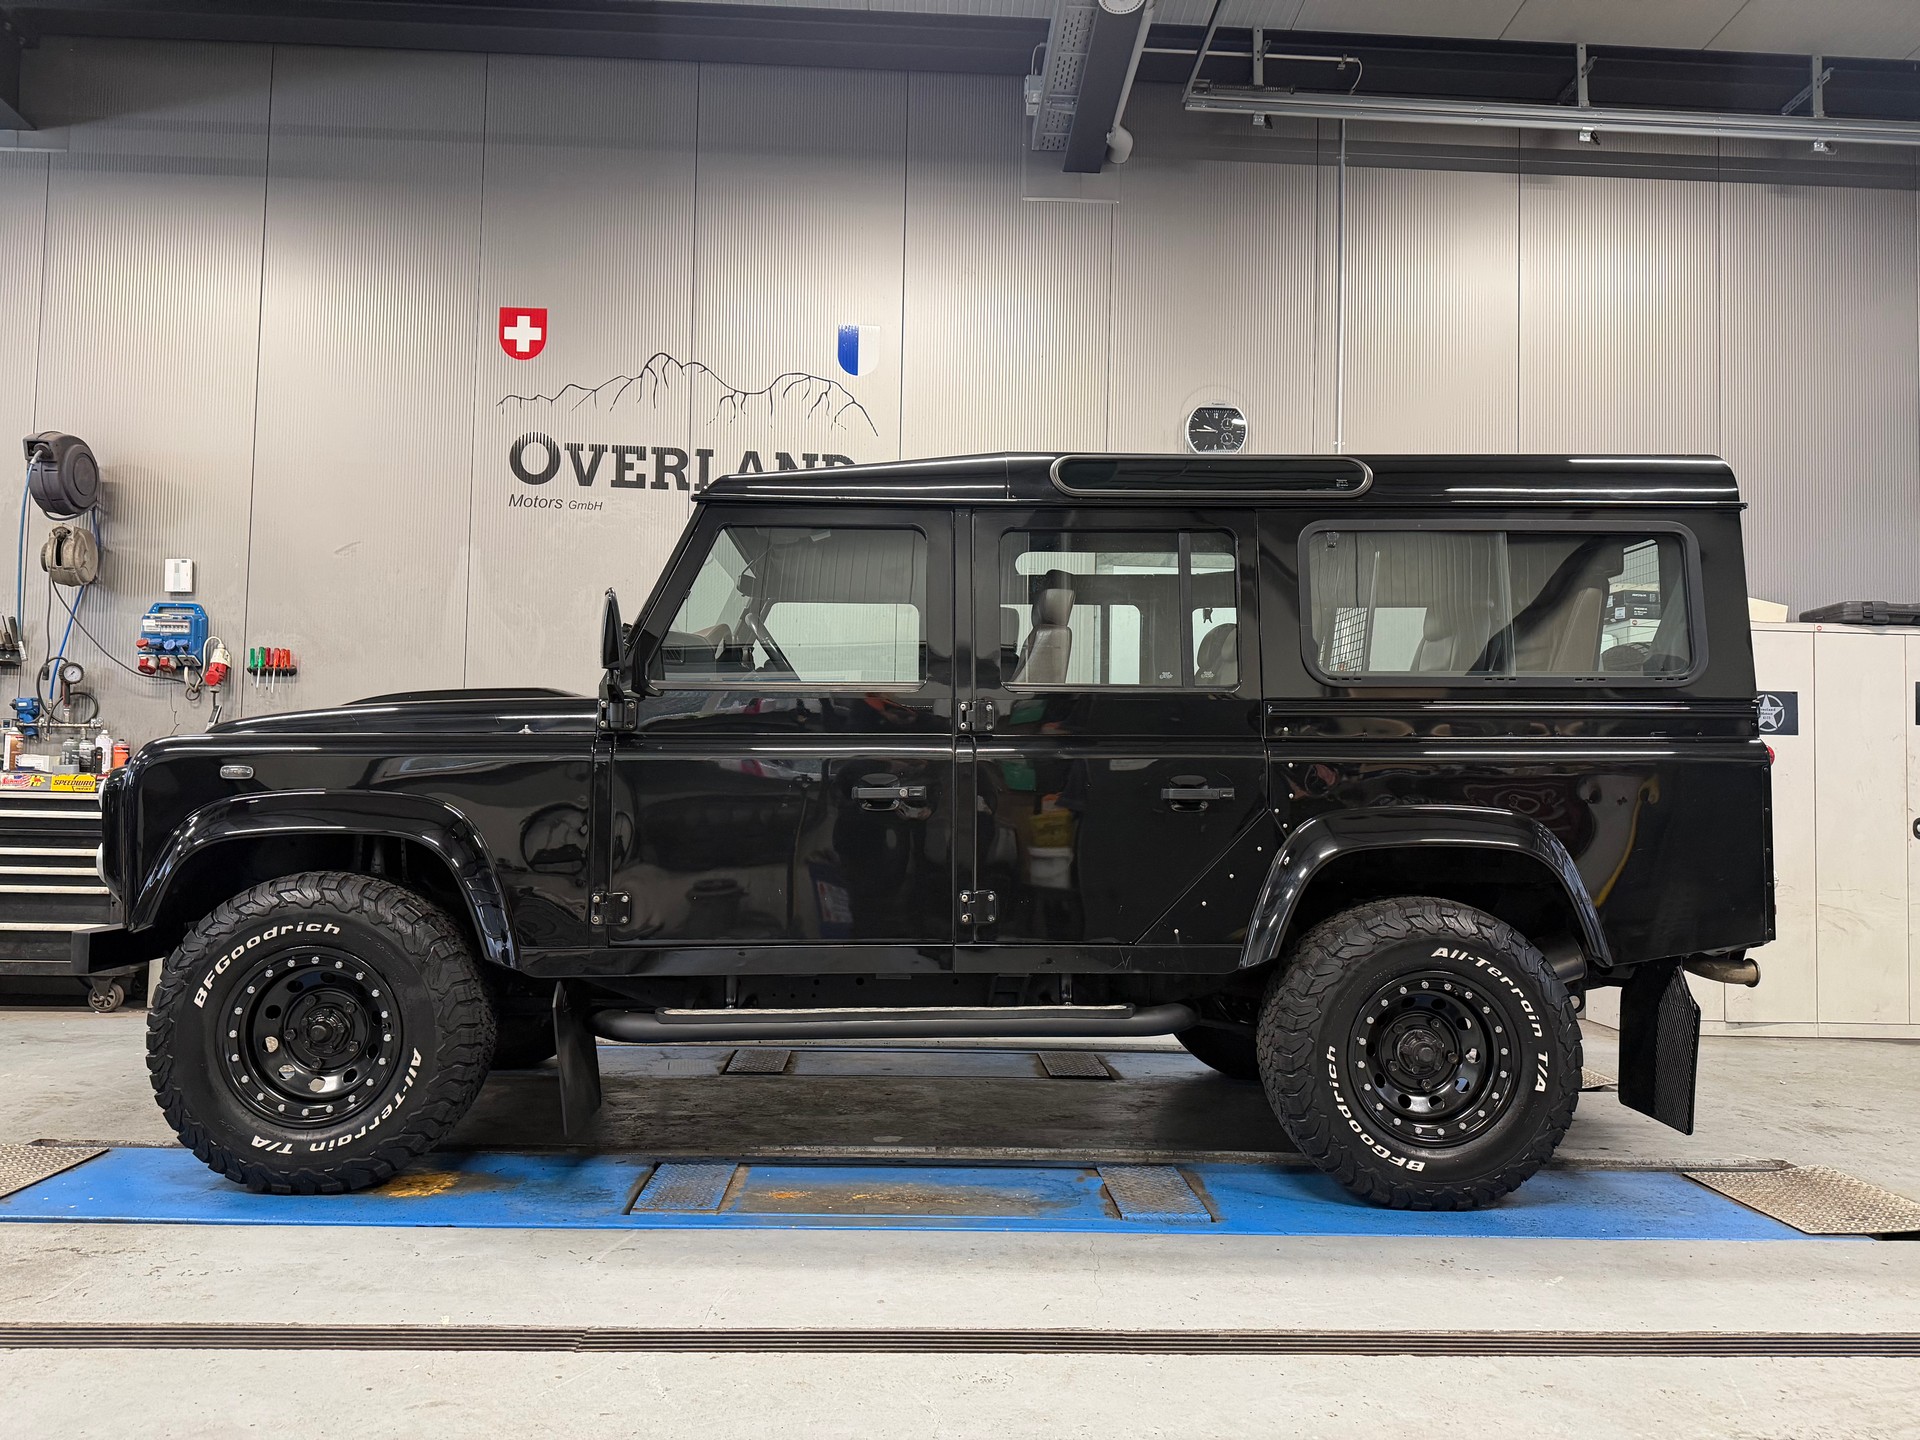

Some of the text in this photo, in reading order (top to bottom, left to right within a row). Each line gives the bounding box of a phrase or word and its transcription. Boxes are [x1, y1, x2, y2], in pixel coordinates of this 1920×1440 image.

[508, 493, 603, 511] Motors GmbH
[509, 431, 856, 491] OVERLA
[193, 921, 341, 1009] BFGoodrich
[1431, 946, 1549, 1093] All-Terrain T/A
[251, 1047, 422, 1155] All-Terrain T/A
[1326, 1045, 1426, 1172] BFGoodrich
